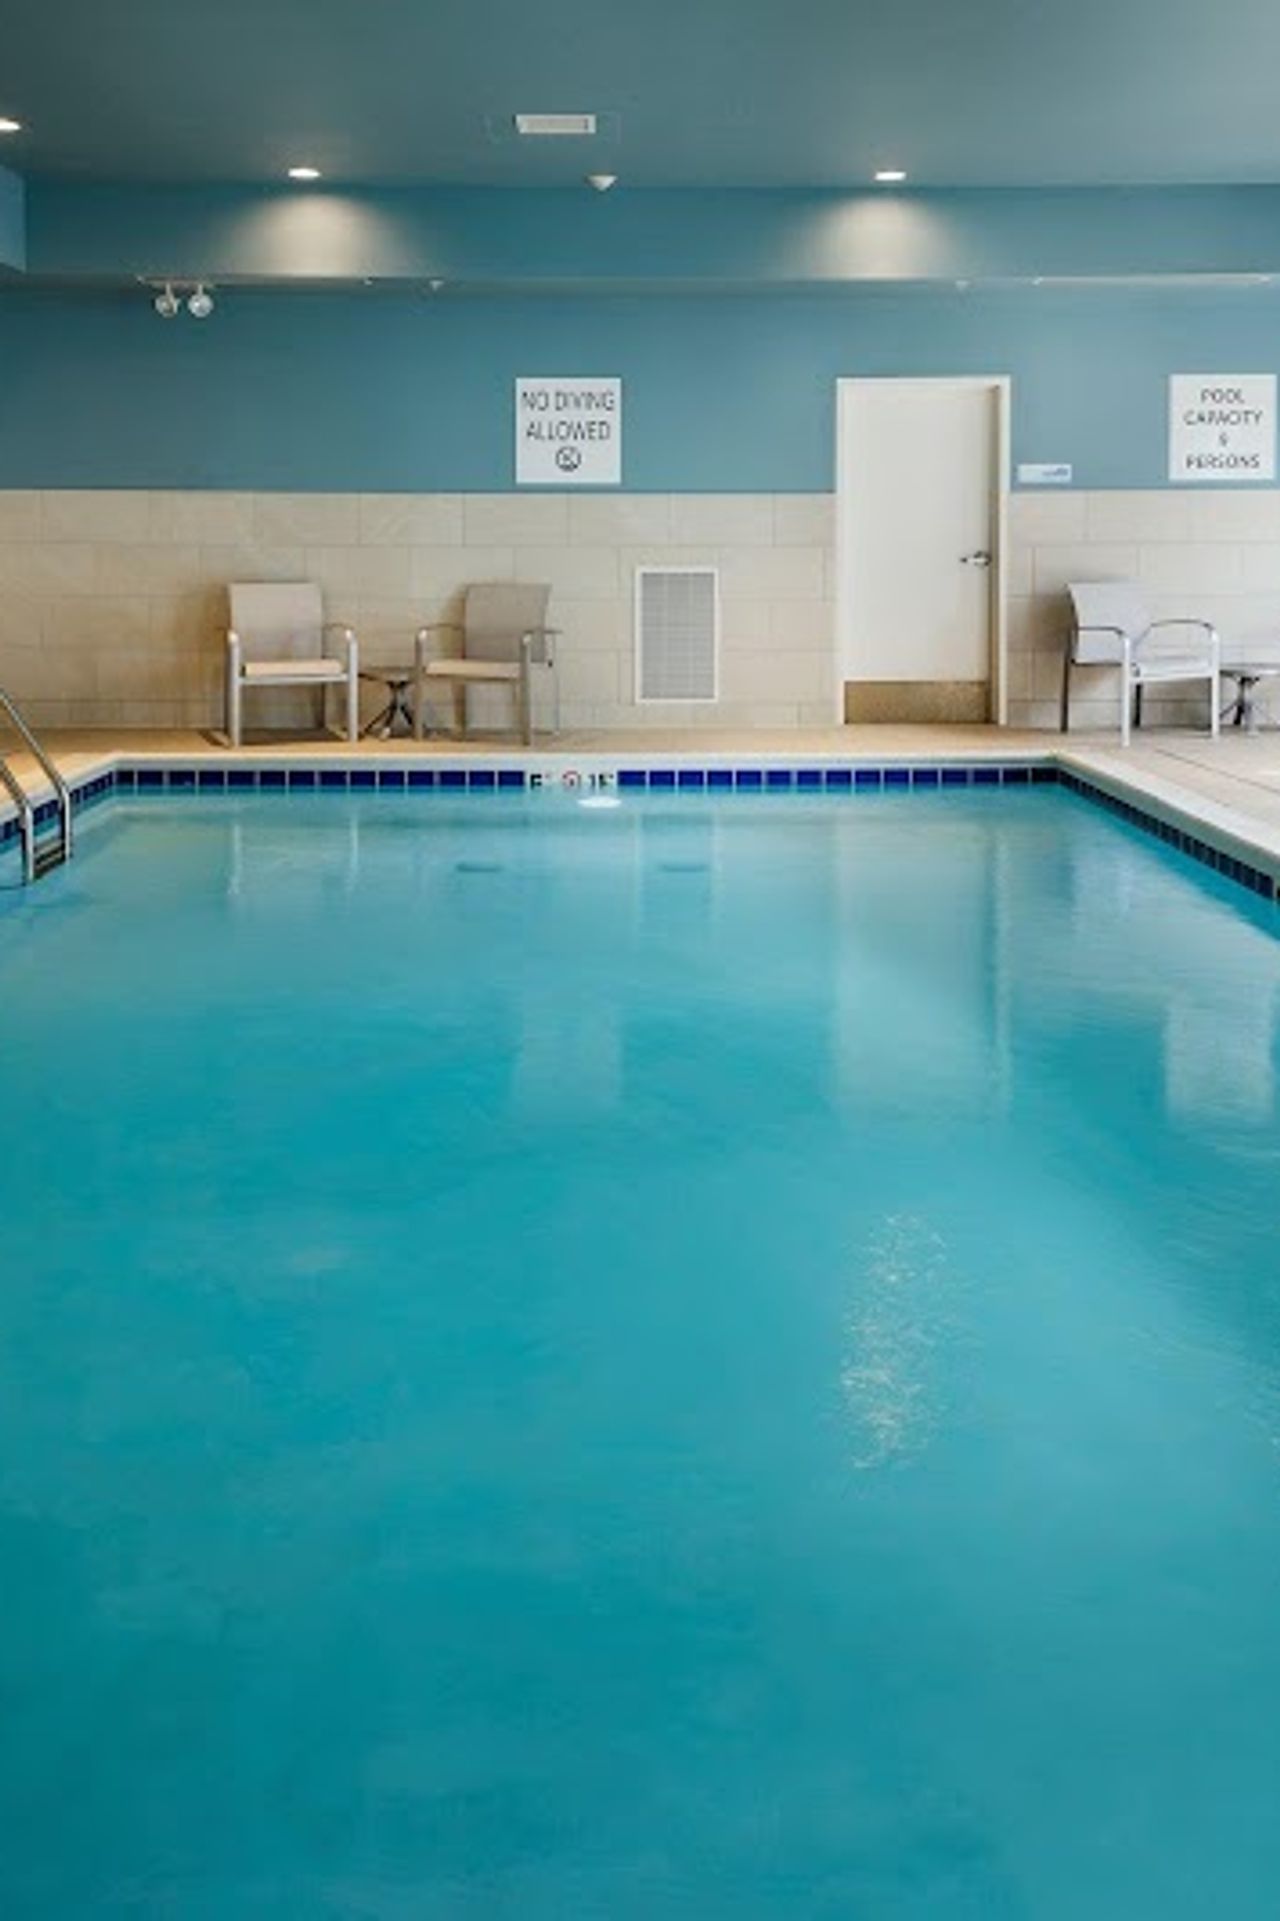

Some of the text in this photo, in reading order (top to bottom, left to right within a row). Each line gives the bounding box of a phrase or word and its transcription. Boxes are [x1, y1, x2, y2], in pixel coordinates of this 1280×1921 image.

[521, 390, 615, 411] NO DIVING
[1200, 387, 1246, 404] POOL
[1182, 409, 1264, 426] CAPACITY
[526, 420, 611, 441] ALLOWED
[1185, 453, 1260, 469] PERSONS
